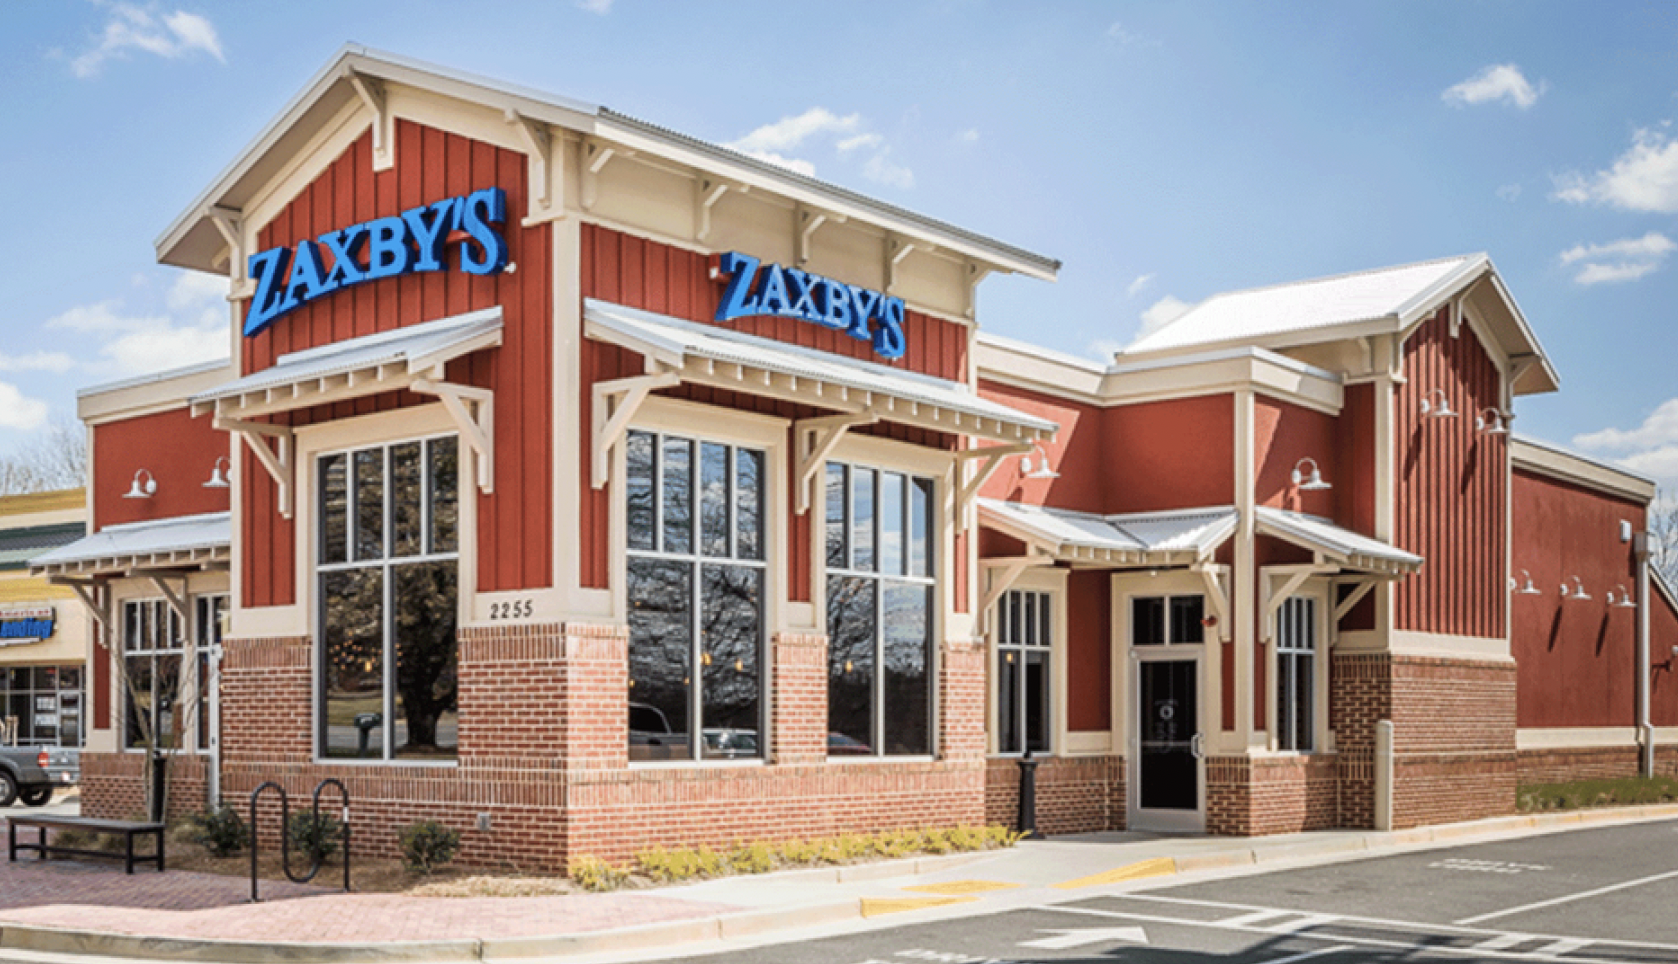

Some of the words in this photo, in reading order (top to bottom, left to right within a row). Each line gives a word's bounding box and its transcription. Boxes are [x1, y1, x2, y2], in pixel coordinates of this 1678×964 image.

[243, 186, 507, 337] ZAXBY'S
[715, 251, 906, 358] ZAXBY'S
[490, 600, 533, 619] 2255
